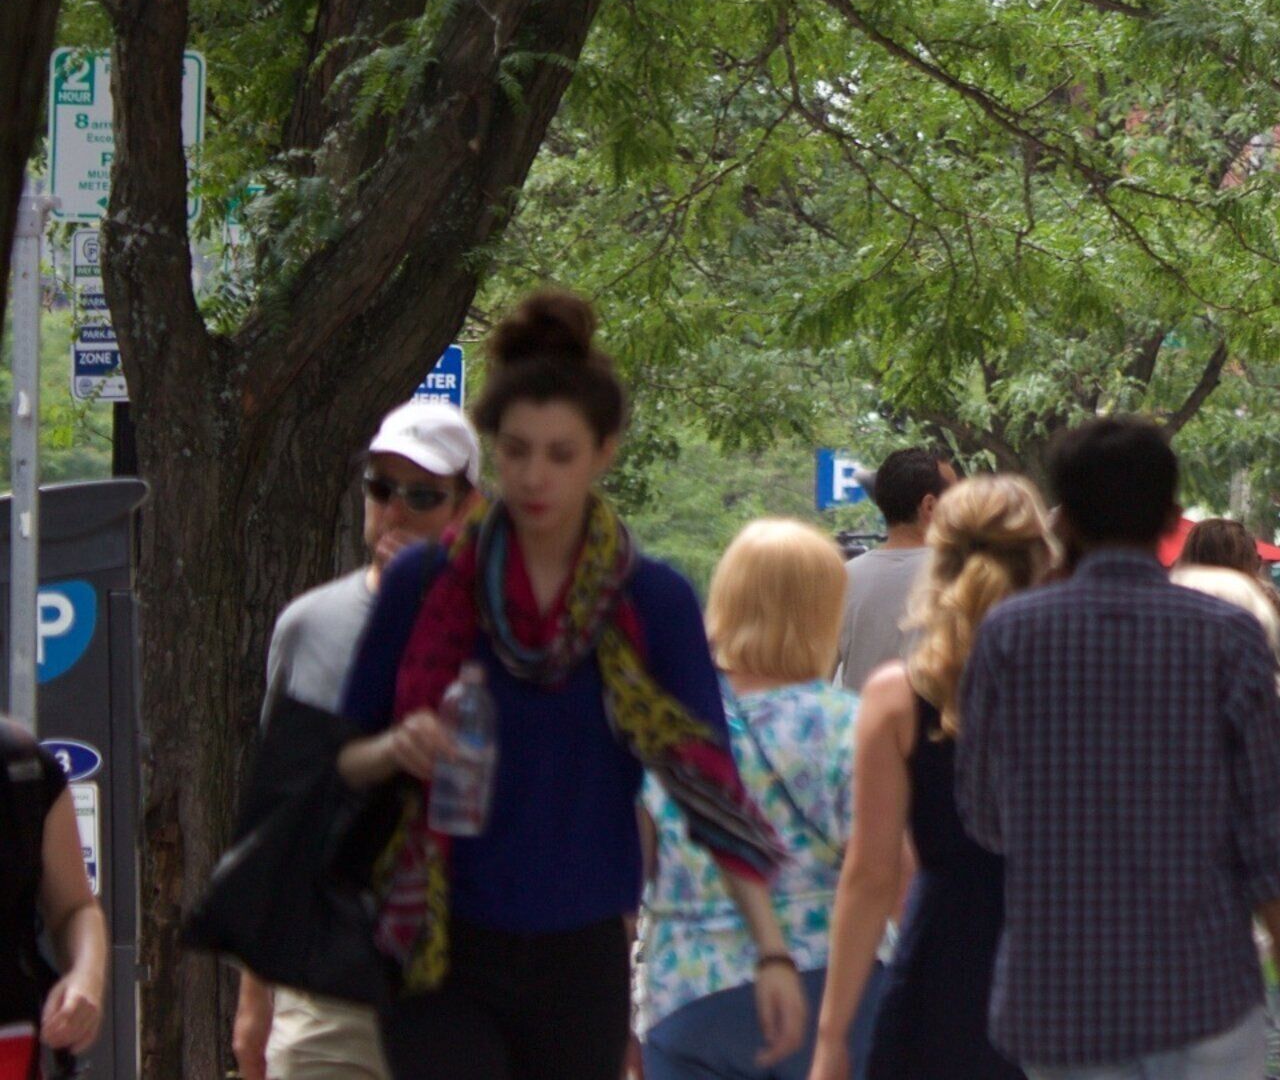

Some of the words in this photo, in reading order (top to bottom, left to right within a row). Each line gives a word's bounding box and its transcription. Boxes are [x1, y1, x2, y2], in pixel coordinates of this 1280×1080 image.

[61, 53, 91, 90] 2
[58, 91, 92, 103] HOUR
[75, 113, 89, 129] 8
[78, 181, 109, 191] METE
[79, 352, 112, 365] ZONE
[419, 373, 457, 389] TER
[36, 592, 75, 665] P
